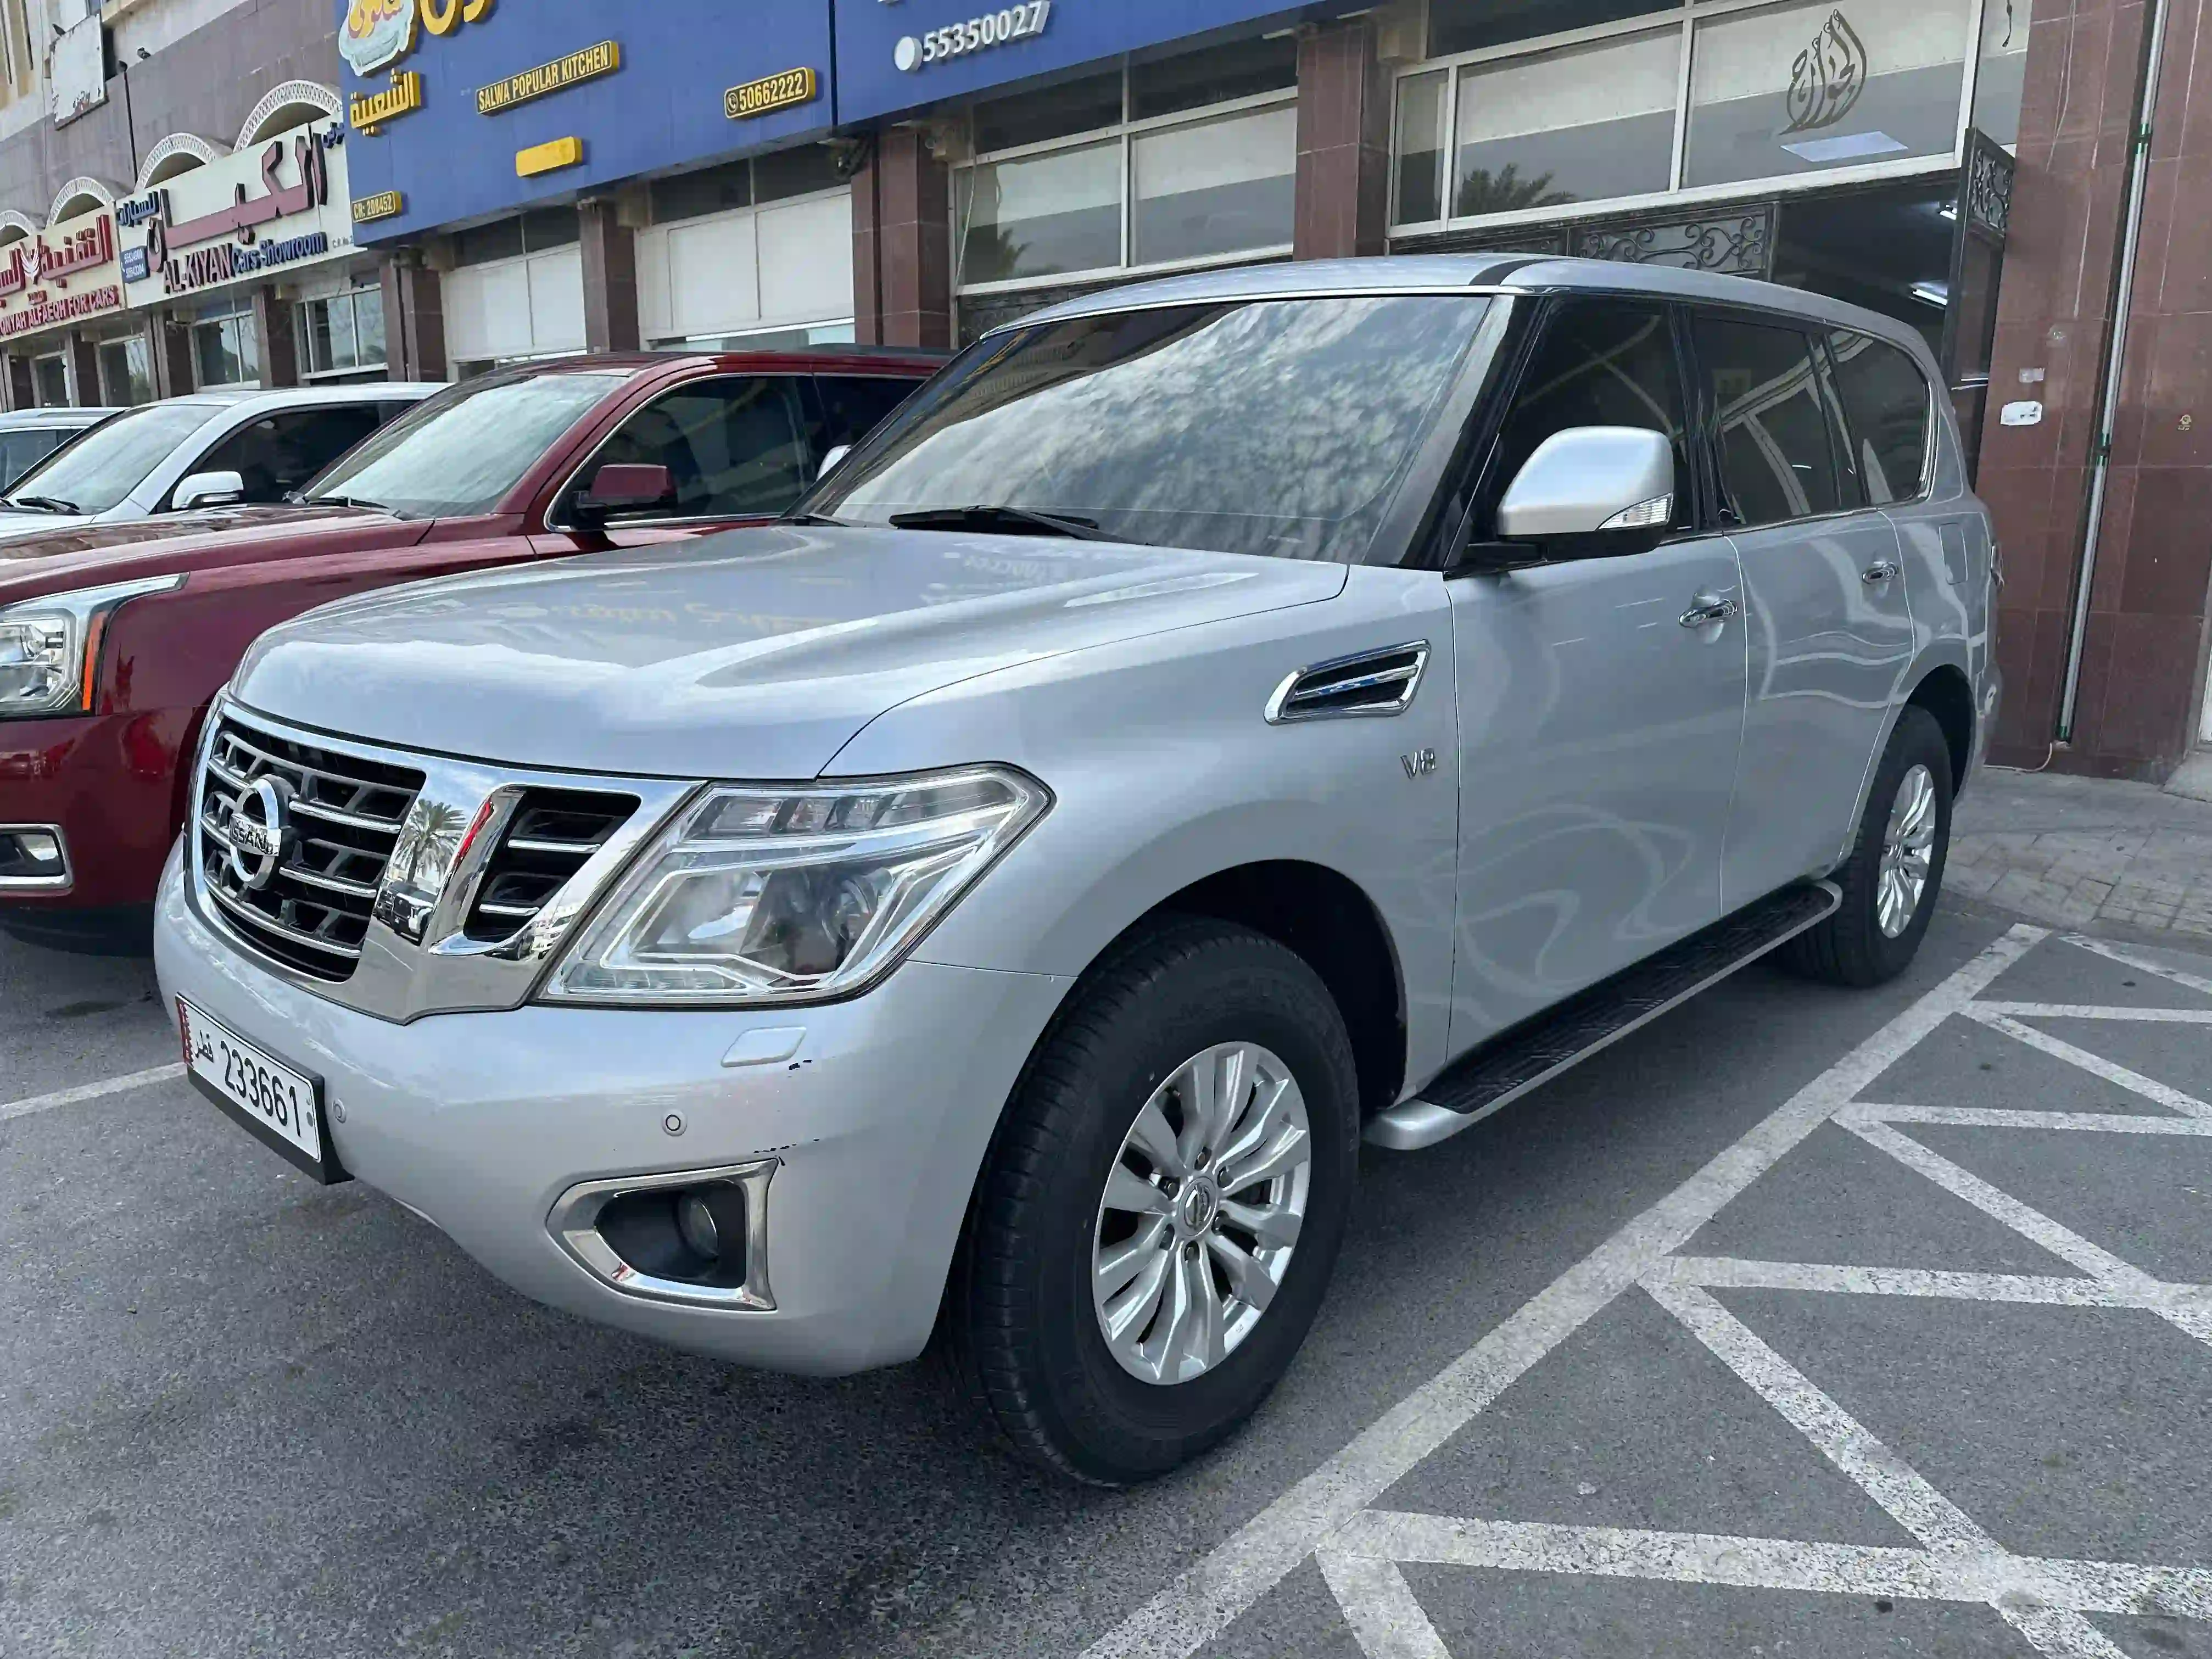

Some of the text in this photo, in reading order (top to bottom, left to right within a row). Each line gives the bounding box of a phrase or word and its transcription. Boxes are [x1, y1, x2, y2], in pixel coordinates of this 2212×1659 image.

[923, 1, 1050, 62] 55350027
[479, 44, 608, 110] SALWA POPULAR KITCHEN
[739, 72, 803, 110] 50662222
[354, 203, 366, 220] CR:
[259, 231, 328, 267] Showroom
[68, 293, 92, 318] FOR
[89, 284, 119, 309] CARS
[1400, 747, 1436, 779] V8
[220, 1040, 302, 1137] 233661
